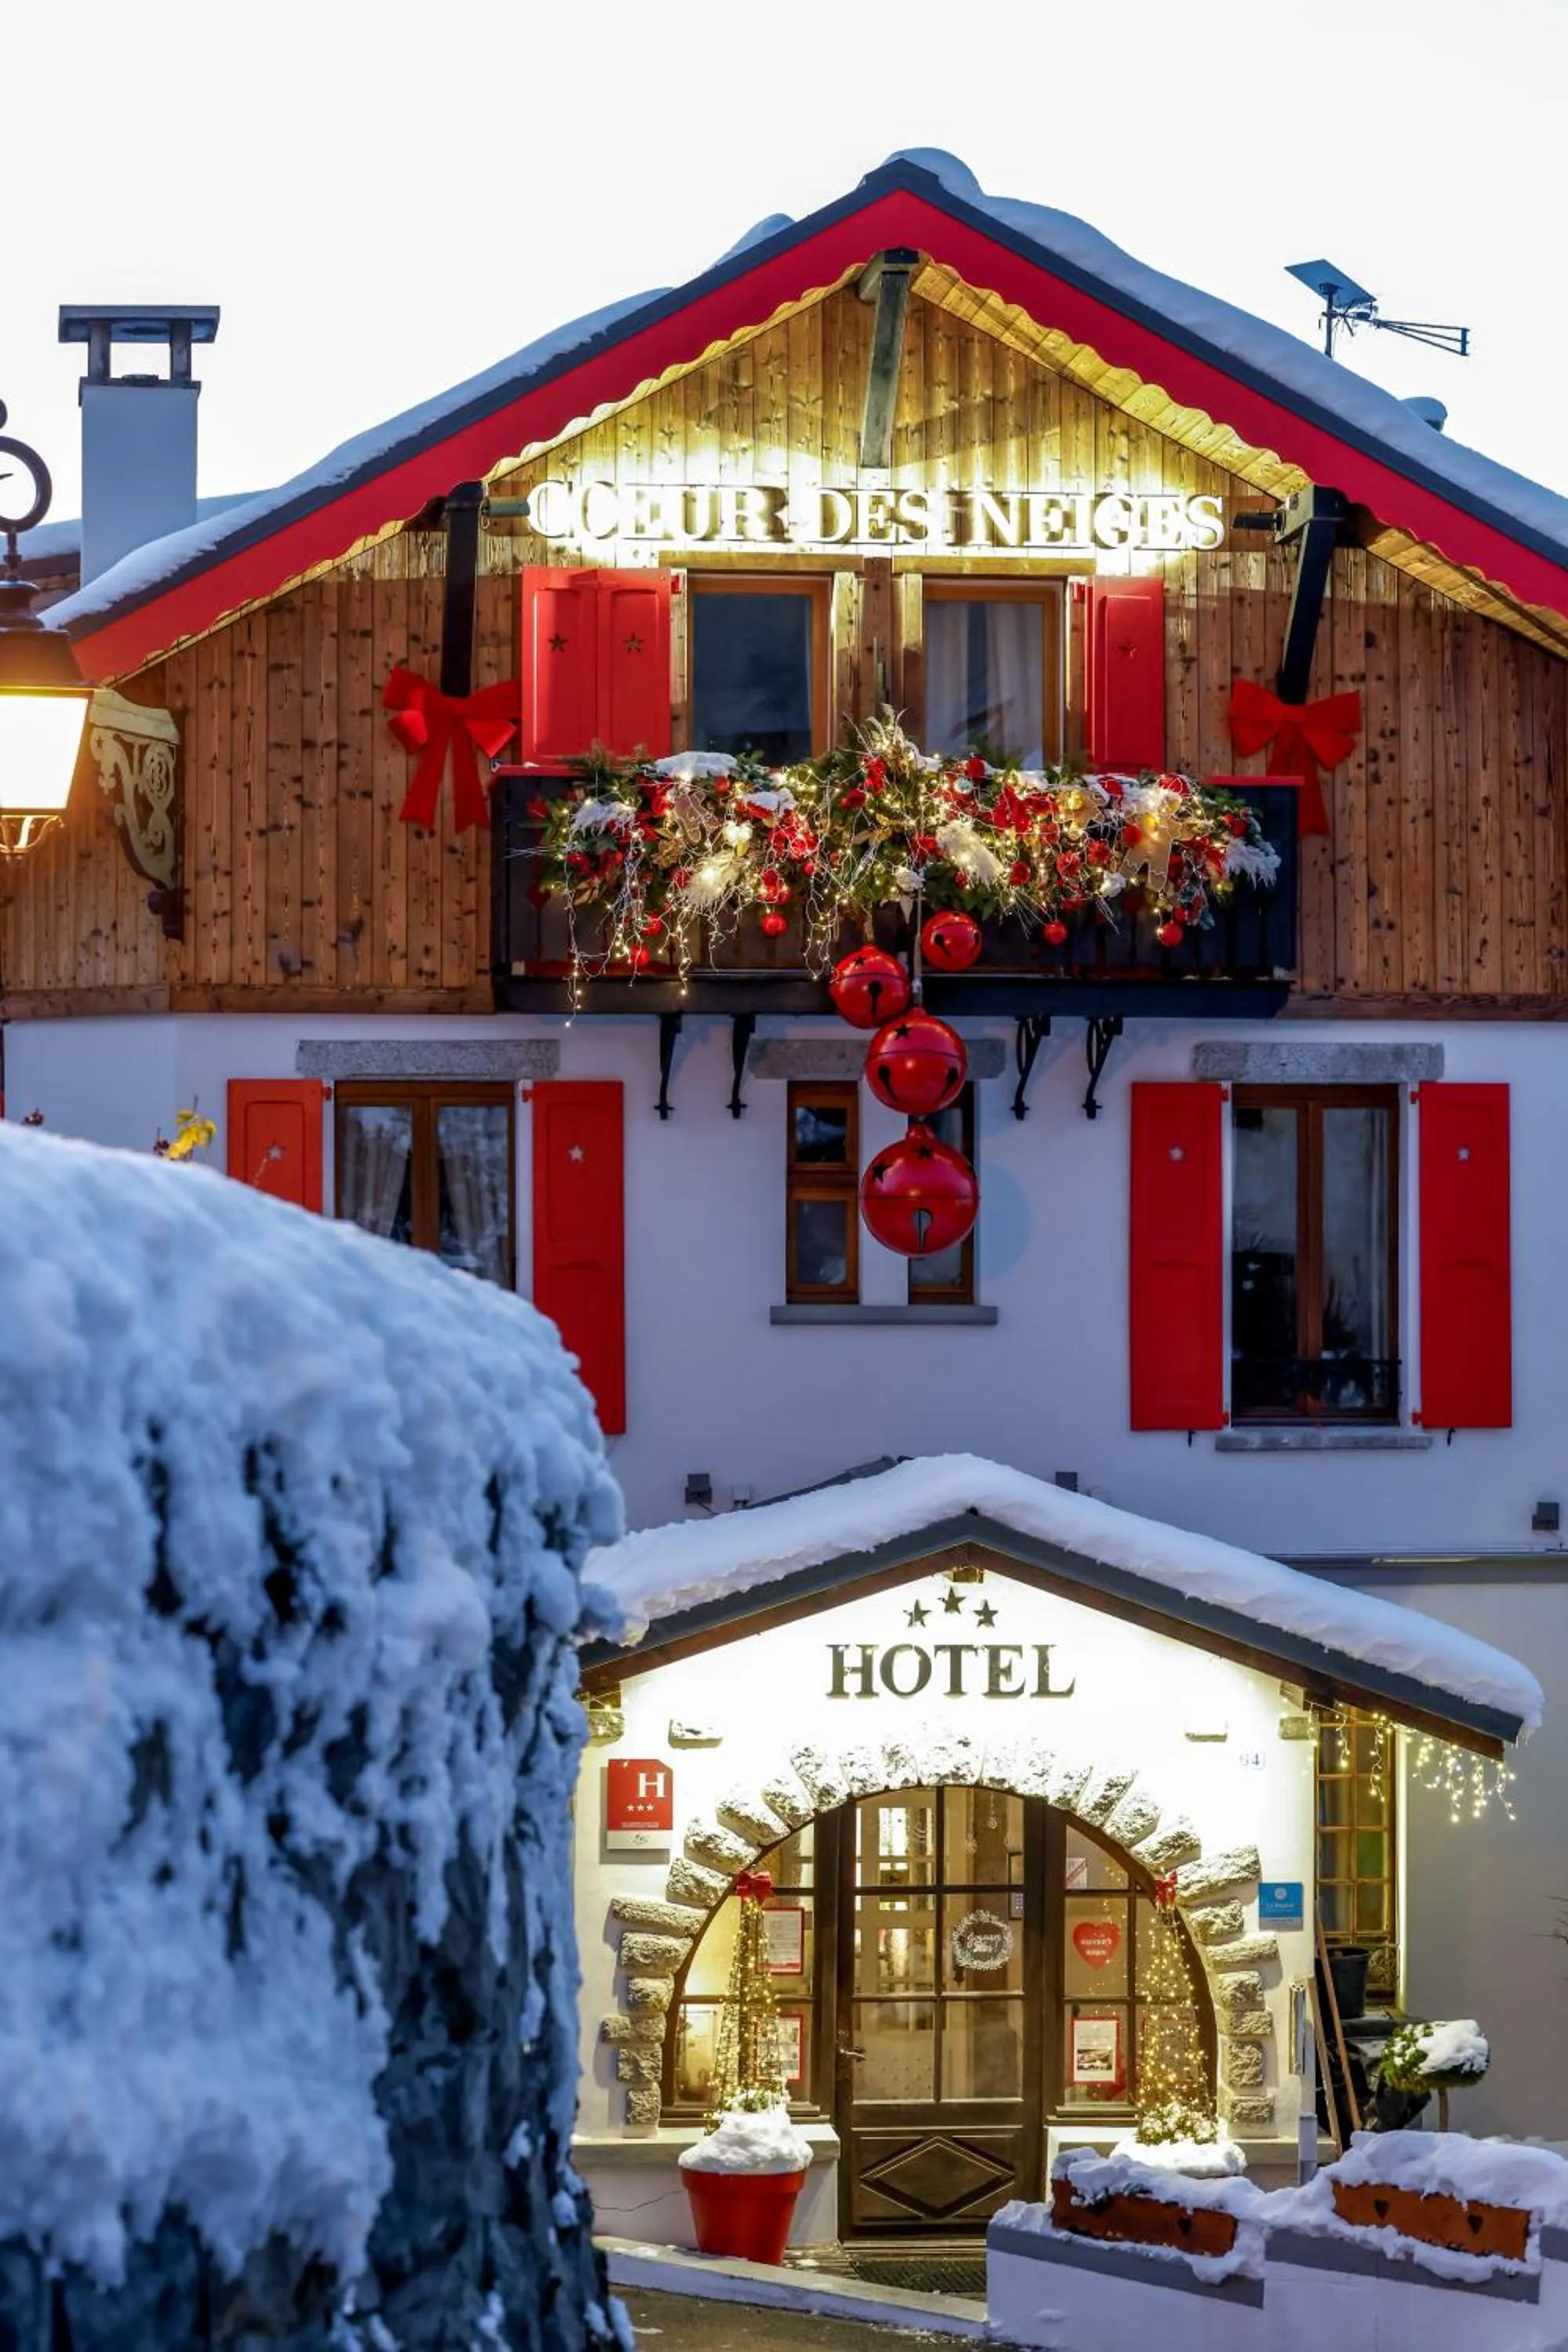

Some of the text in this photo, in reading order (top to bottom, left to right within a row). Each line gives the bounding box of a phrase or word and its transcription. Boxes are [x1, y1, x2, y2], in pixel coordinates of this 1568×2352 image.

[805, 488, 935, 544] DES
[966, 492, 1225, 550] NEIGES
[825, 1643, 1076, 1699] HOTEL
[637, 1772, 665, 1798] H
